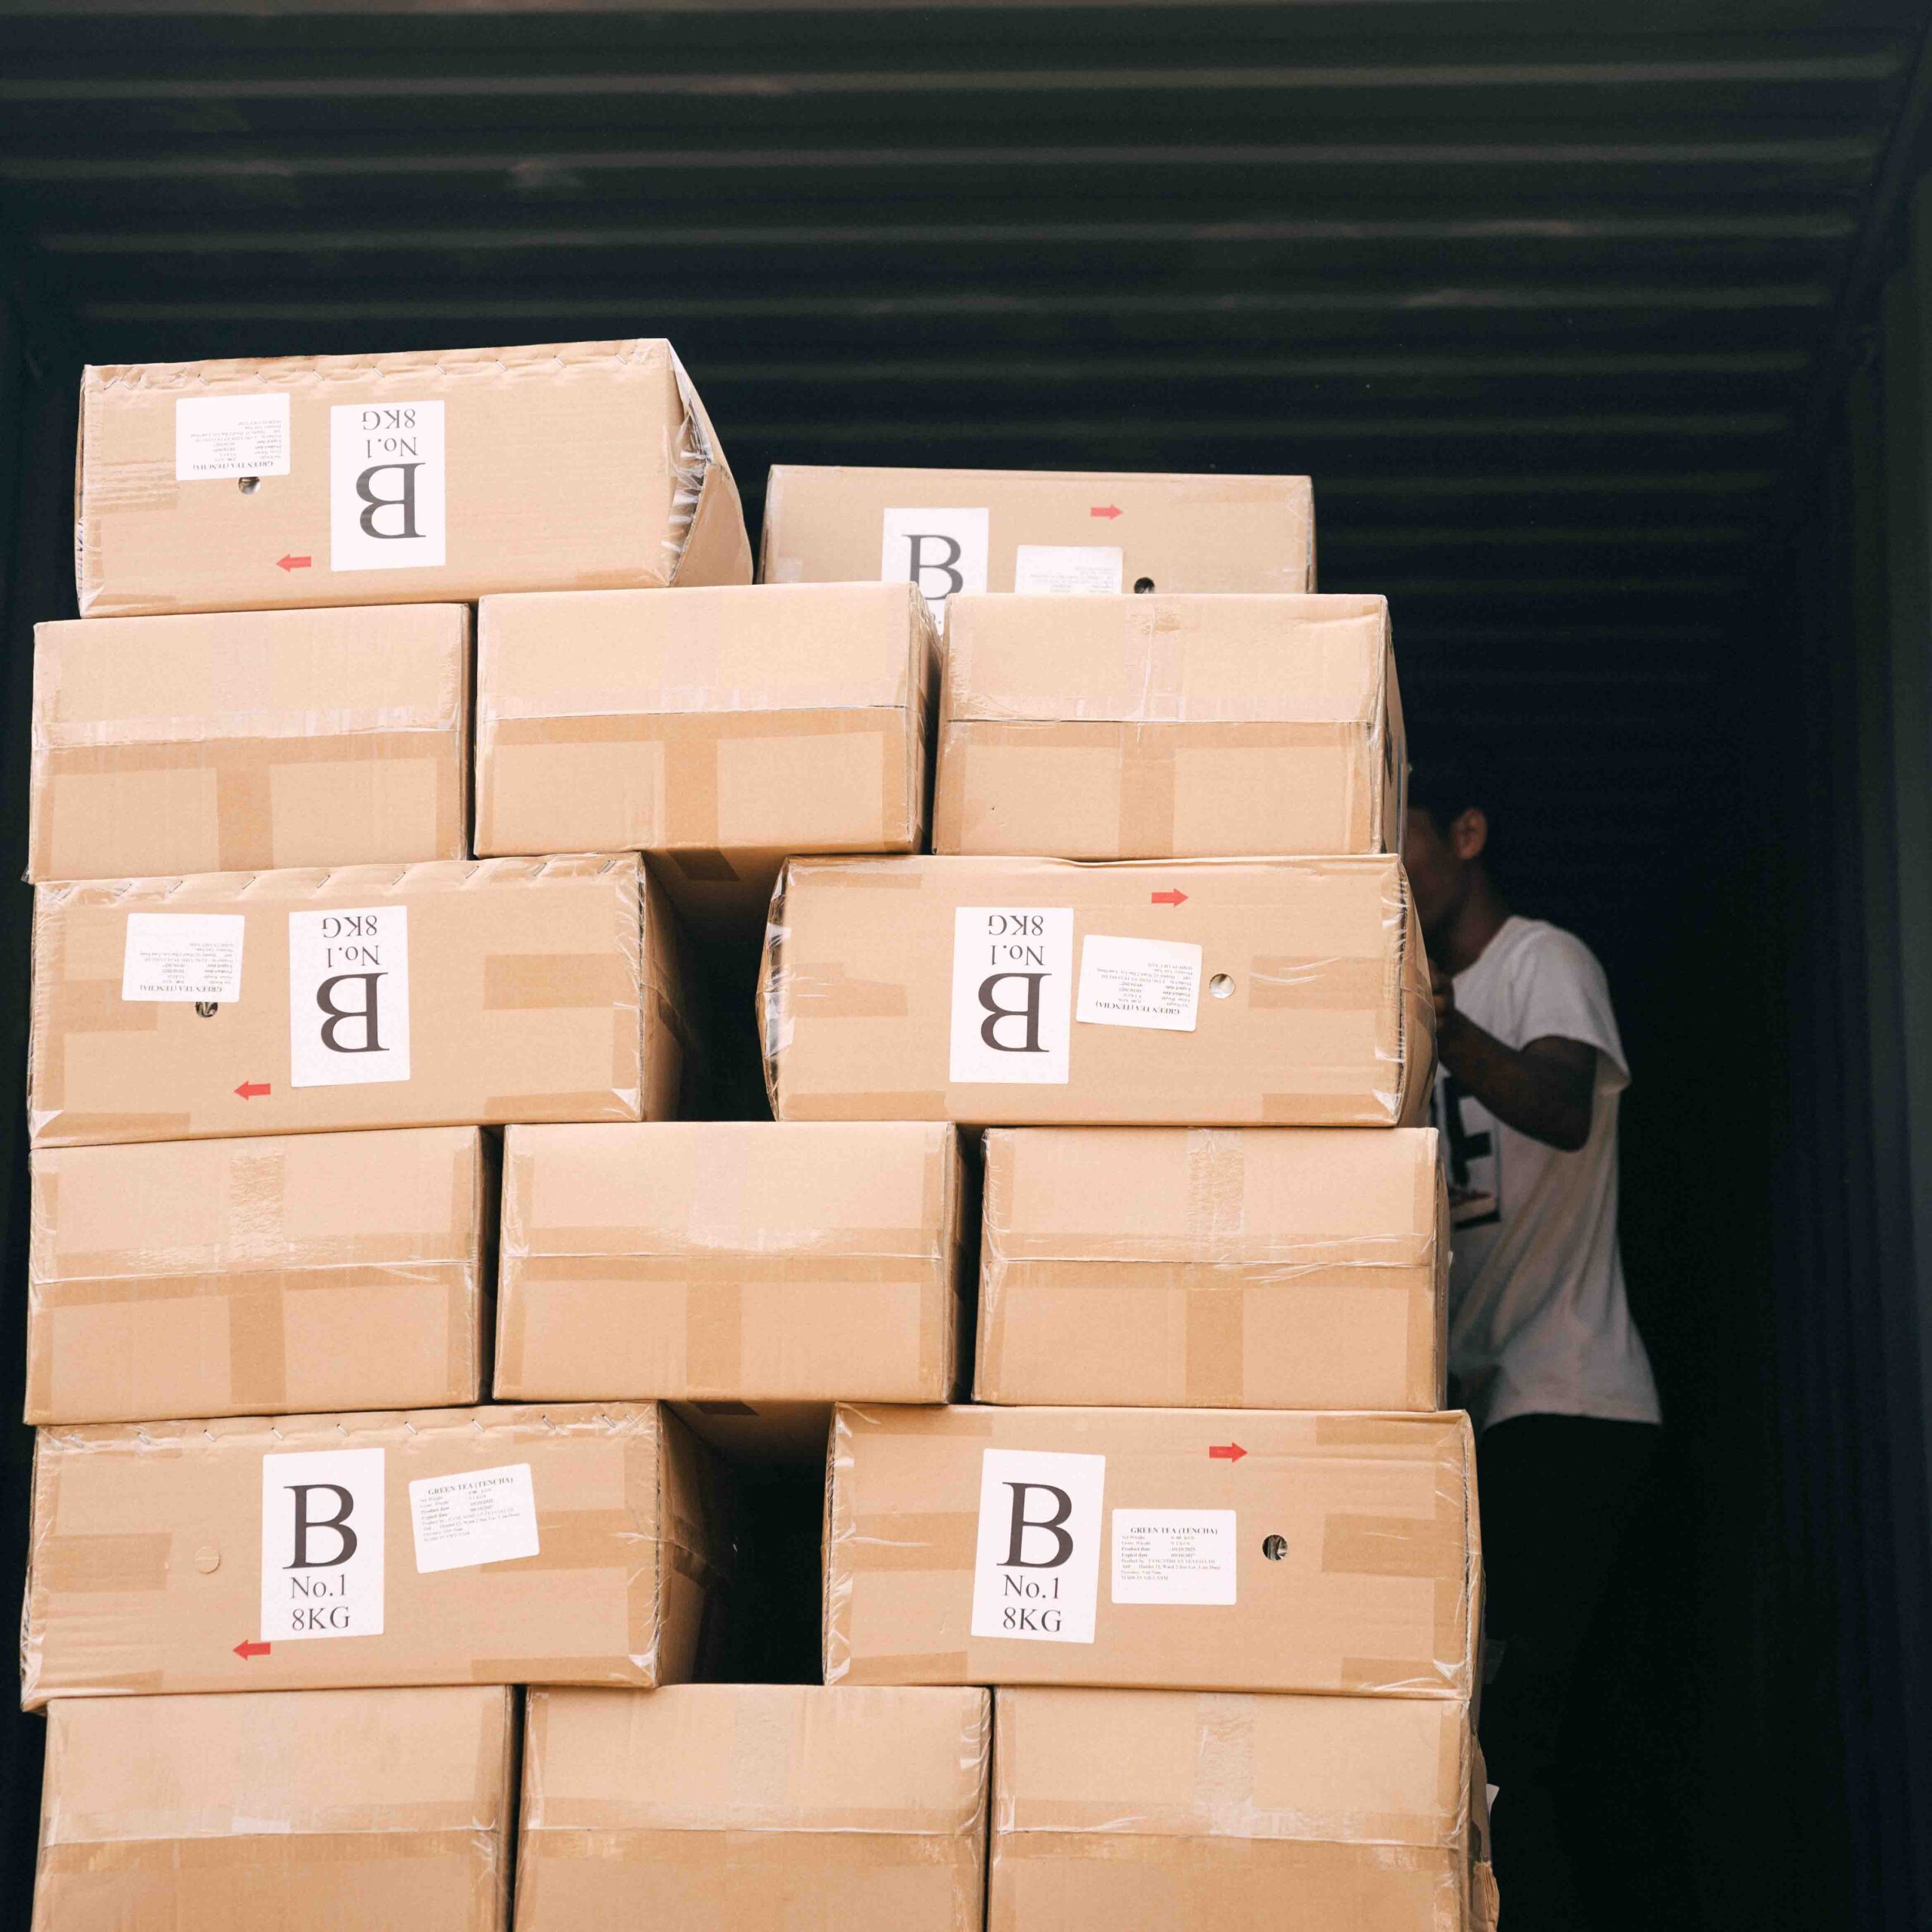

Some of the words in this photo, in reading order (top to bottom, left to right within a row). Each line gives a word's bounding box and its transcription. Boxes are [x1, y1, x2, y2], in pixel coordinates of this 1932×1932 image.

[362, 409, 416, 430] 8KG
[367, 437, 417, 459] No.1
[355, 463, 426, 539] B
[901, 534, 964, 601] B
[322, 915, 377, 938] 8KG
[988, 915, 1044, 936] 8KG
[327, 945, 380, 968] No.1
[991, 945, 1044, 966] No.1
[317, 973, 389, 1053] B
[978, 973, 1051, 1052] B
[282, 1484, 358, 1569] B
[996, 1481, 1074, 1569] B
[291, 1574, 345, 1599] No.1
[1004, 1574, 1059, 1599] No.1
[292, 1606, 349, 1631] 8KG
[1003, 1607, 1061, 1632] 8KG
